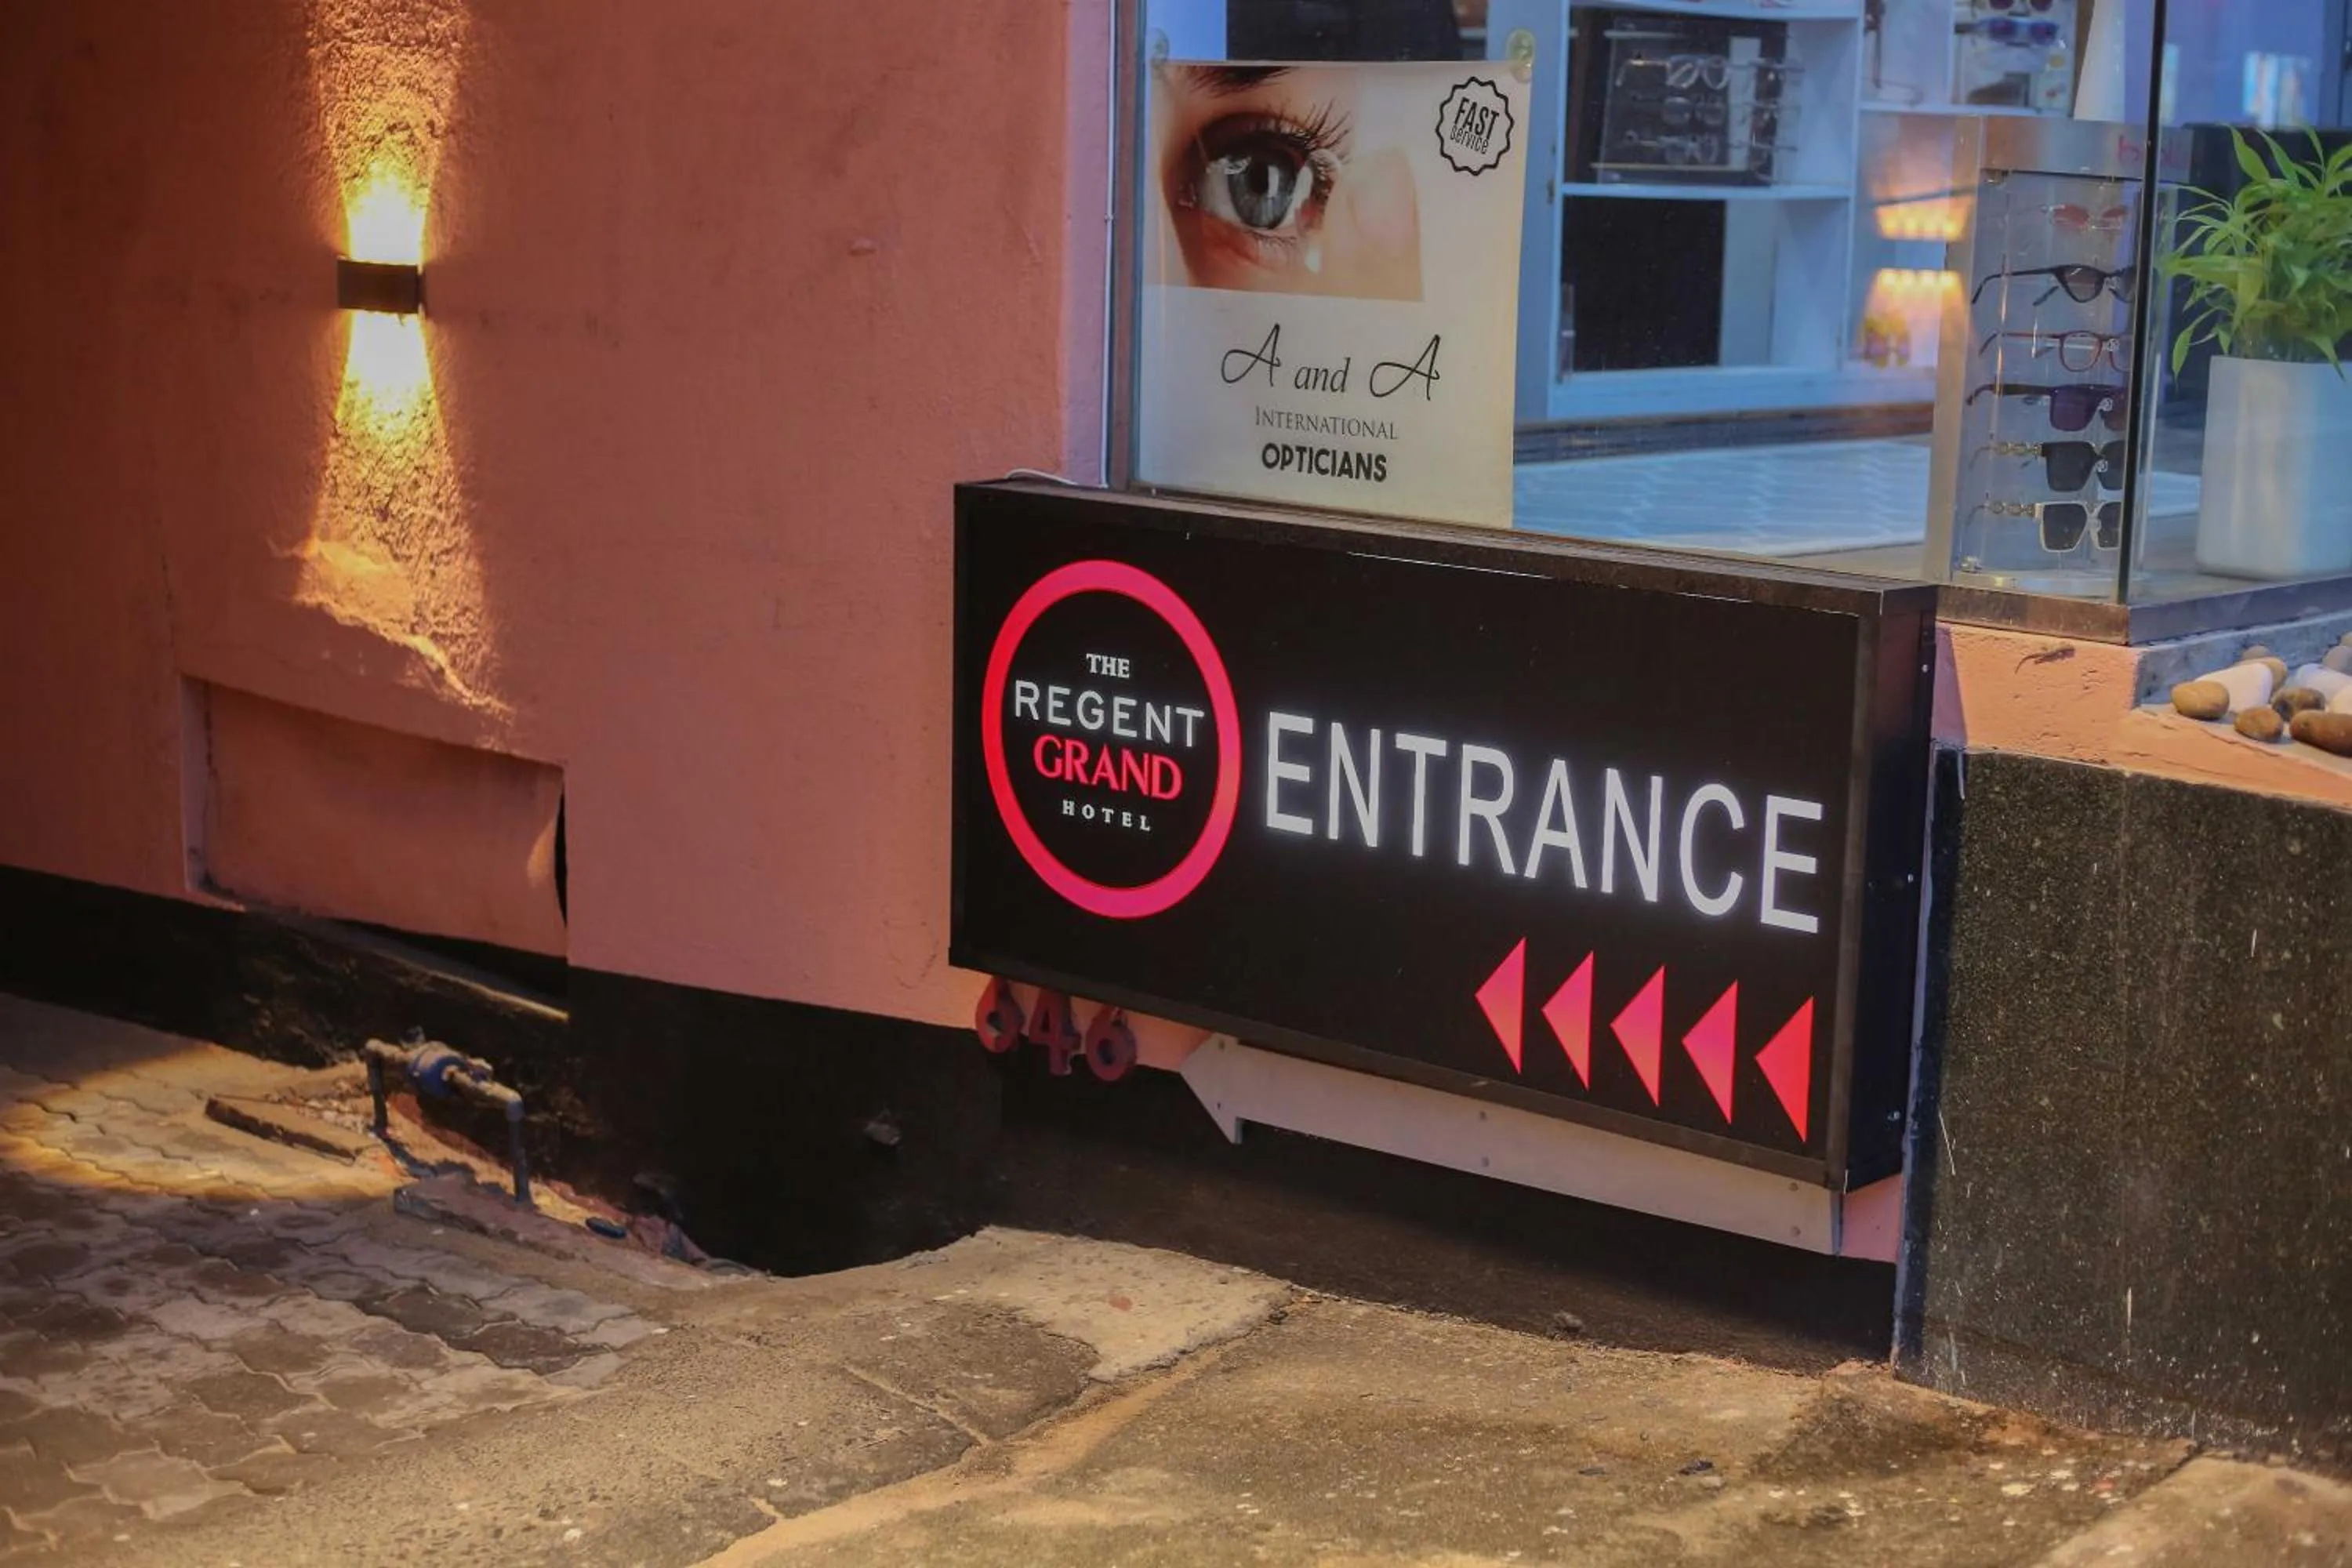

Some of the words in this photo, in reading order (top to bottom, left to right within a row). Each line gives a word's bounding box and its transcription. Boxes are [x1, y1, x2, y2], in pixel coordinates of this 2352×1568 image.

[1454, 96, 1500, 140] FAST
[1221, 322, 1281, 387] A
[1294, 358, 1351, 394] and
[1370, 334, 1440, 401] A
[1255, 406, 1399, 440] INTERNATIONAL
[1261, 443, 1387, 482] OPTICIANS
[1086, 653, 1131, 679] THE
[1014, 680, 1205, 748] REGENT
[1033, 734, 1183, 800] GRAND
[1062, 800, 1151, 832] HOTEL
[1265, 710, 1823, 934] ENTRANCE
